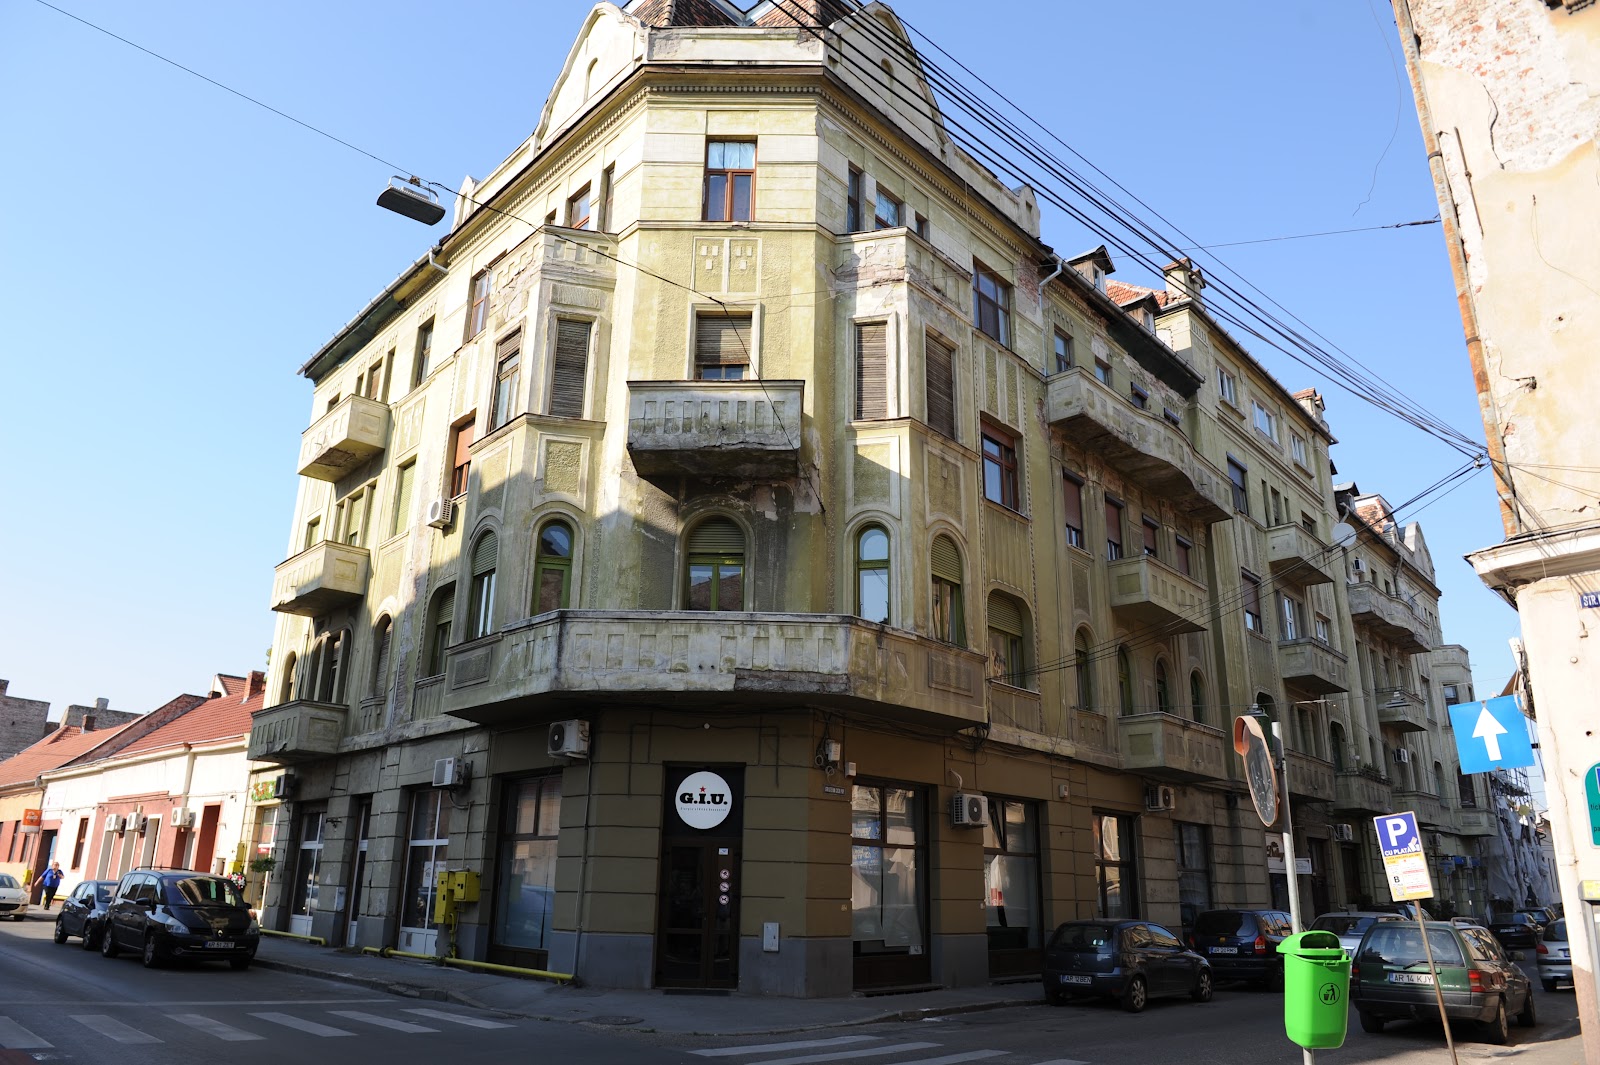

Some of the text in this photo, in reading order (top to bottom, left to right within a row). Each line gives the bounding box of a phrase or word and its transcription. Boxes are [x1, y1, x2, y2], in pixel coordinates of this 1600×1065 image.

[679, 792, 728, 805] G.I.U.
[1386, 818, 1407, 846] P
[1394, 974, 1405, 982] AR
[1416, 975, 1432, 983] KJY
